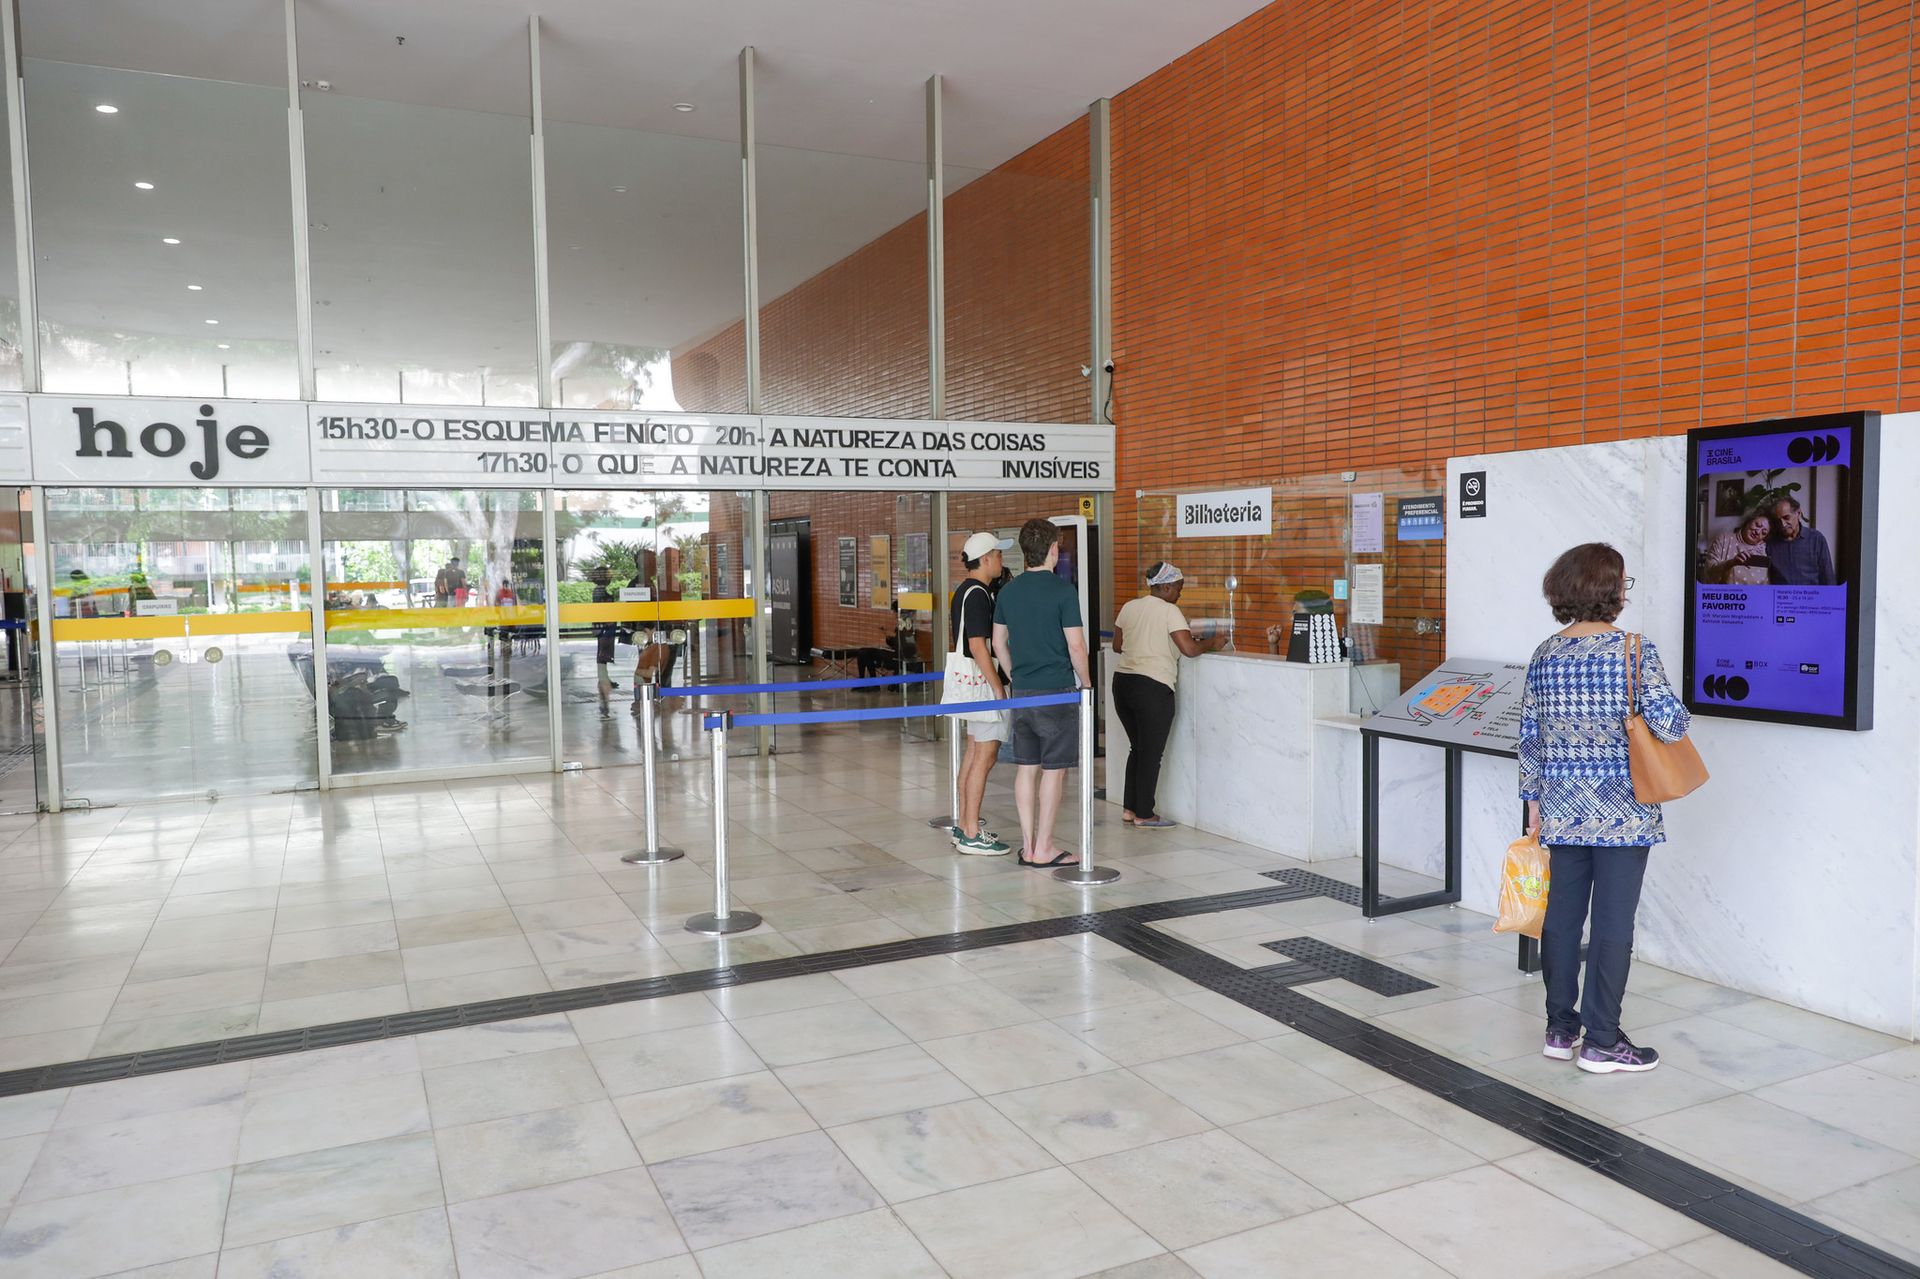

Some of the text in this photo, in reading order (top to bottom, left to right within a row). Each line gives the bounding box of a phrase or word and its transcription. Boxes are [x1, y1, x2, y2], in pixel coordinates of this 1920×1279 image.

[72, 404, 270, 480] hoje
[444, 419, 585, 442] ESQUEMA
[593, 418, 694, 444] FENÍCIO
[793, 428, 916, 450] NATUREZA
[923, 431, 965, 451] DAS
[970, 432, 1046, 451] COISAS
[597, 454, 656, 475] QUE
[670, 455, 689, 475] A
[700, 455, 832, 477] NATUREZA
[839, 458, 868, 477] TE
[878, 459, 957, 478] CONTA
[1002, 456, 1100, 479] INVISÍVEIS
[1185, 500, 1262, 525] Bilheteria
[1402, 503, 1436, 511] ATENDIMENTO
[1702, 593, 1748, 601] MEU BOLO
[1702, 602, 1746, 611] FAVORITO
